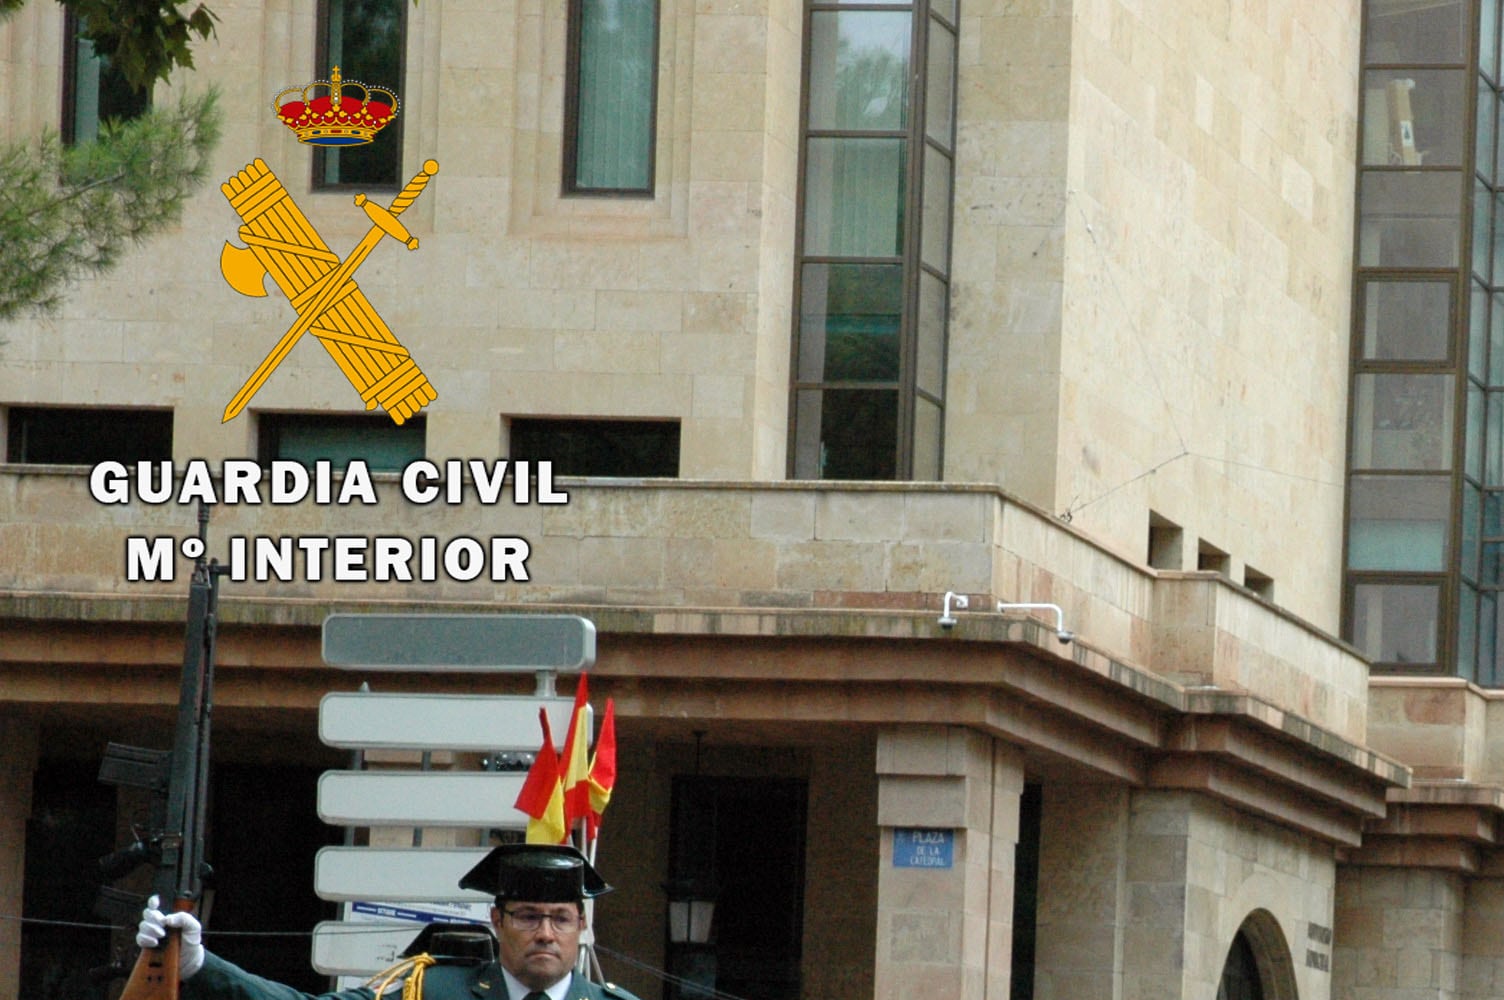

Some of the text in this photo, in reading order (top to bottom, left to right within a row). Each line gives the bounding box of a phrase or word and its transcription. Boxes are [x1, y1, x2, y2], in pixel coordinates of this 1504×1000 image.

[912, 831, 945, 844] PLAZA
[916, 845, 941, 857] DE LA
